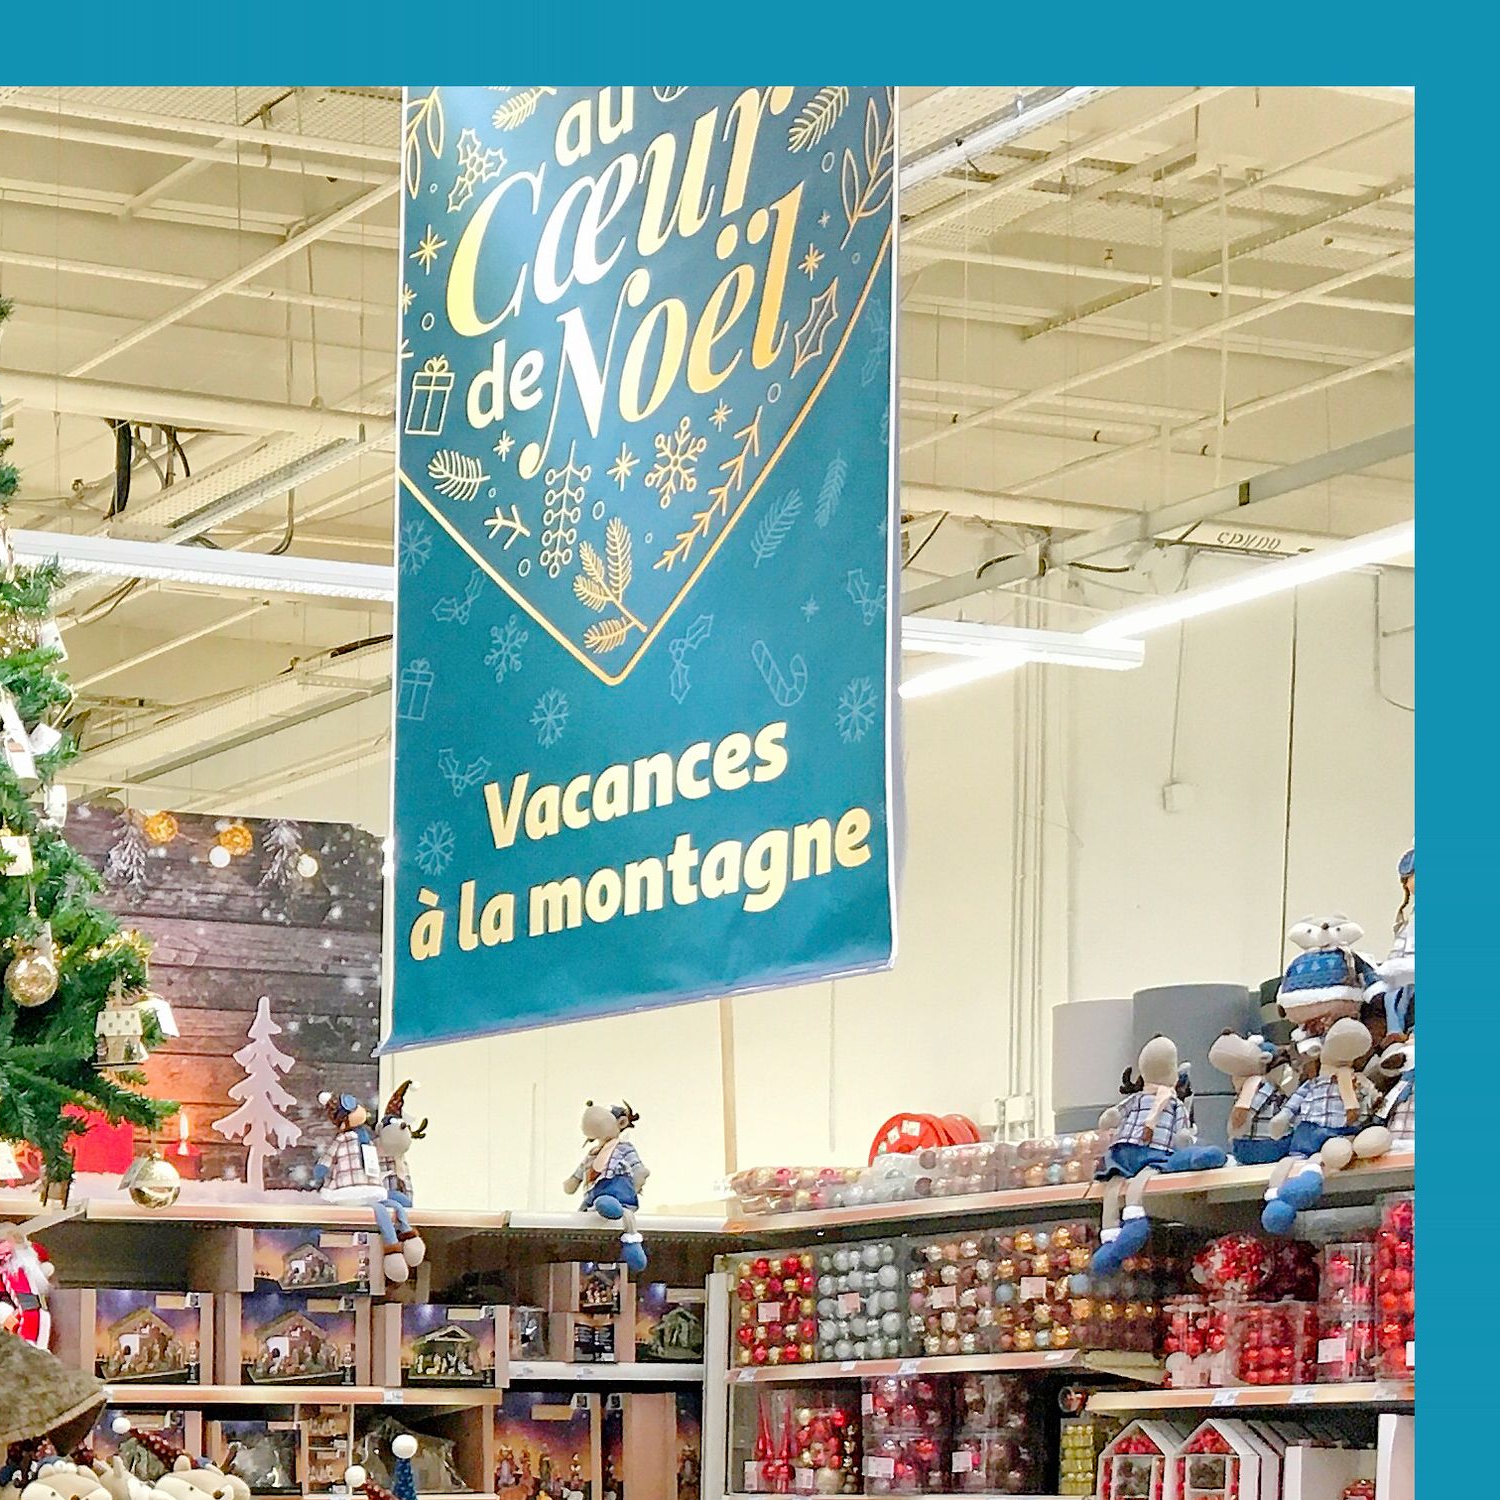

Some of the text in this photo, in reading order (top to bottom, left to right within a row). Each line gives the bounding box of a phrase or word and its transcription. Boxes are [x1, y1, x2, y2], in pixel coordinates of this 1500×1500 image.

[466, 181, 804, 480] de Noël
[483, 721, 789, 850] Vacances
[409, 806, 873, 961] à la montagne
